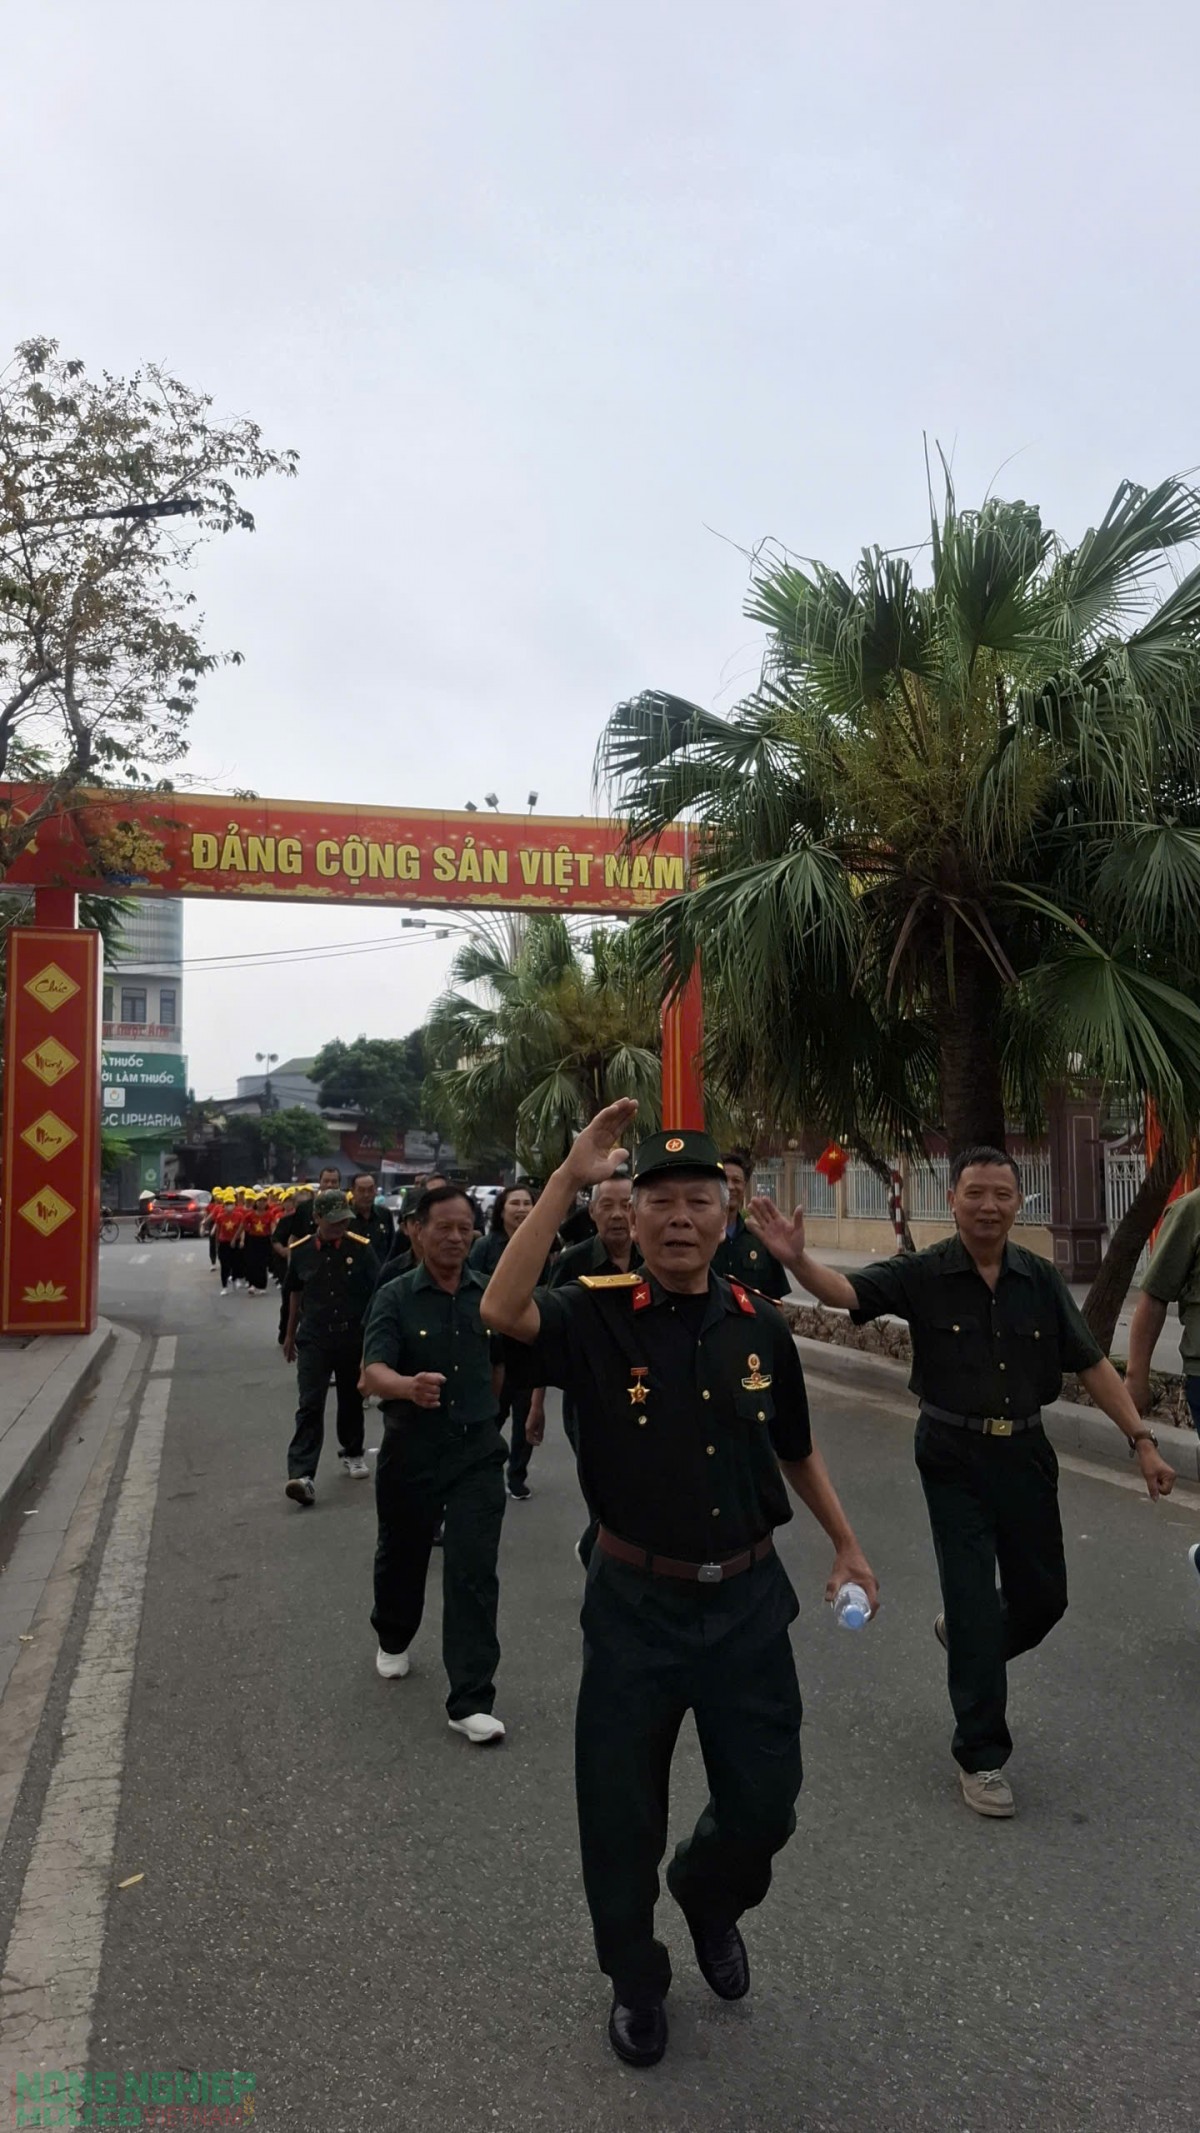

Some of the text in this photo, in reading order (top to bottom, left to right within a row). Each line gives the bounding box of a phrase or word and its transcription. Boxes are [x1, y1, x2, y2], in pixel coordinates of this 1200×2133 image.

[191, 823, 685, 894] ĐẢNG CỘNG SẢN VIỆT NAM
[109, 1054, 144, 1067] THUỐC
[116, 1070, 139, 1083] LÀM
[140, 1070, 175, 1085] THUỐC
[121, 1112, 182, 1128] UPHARMA
